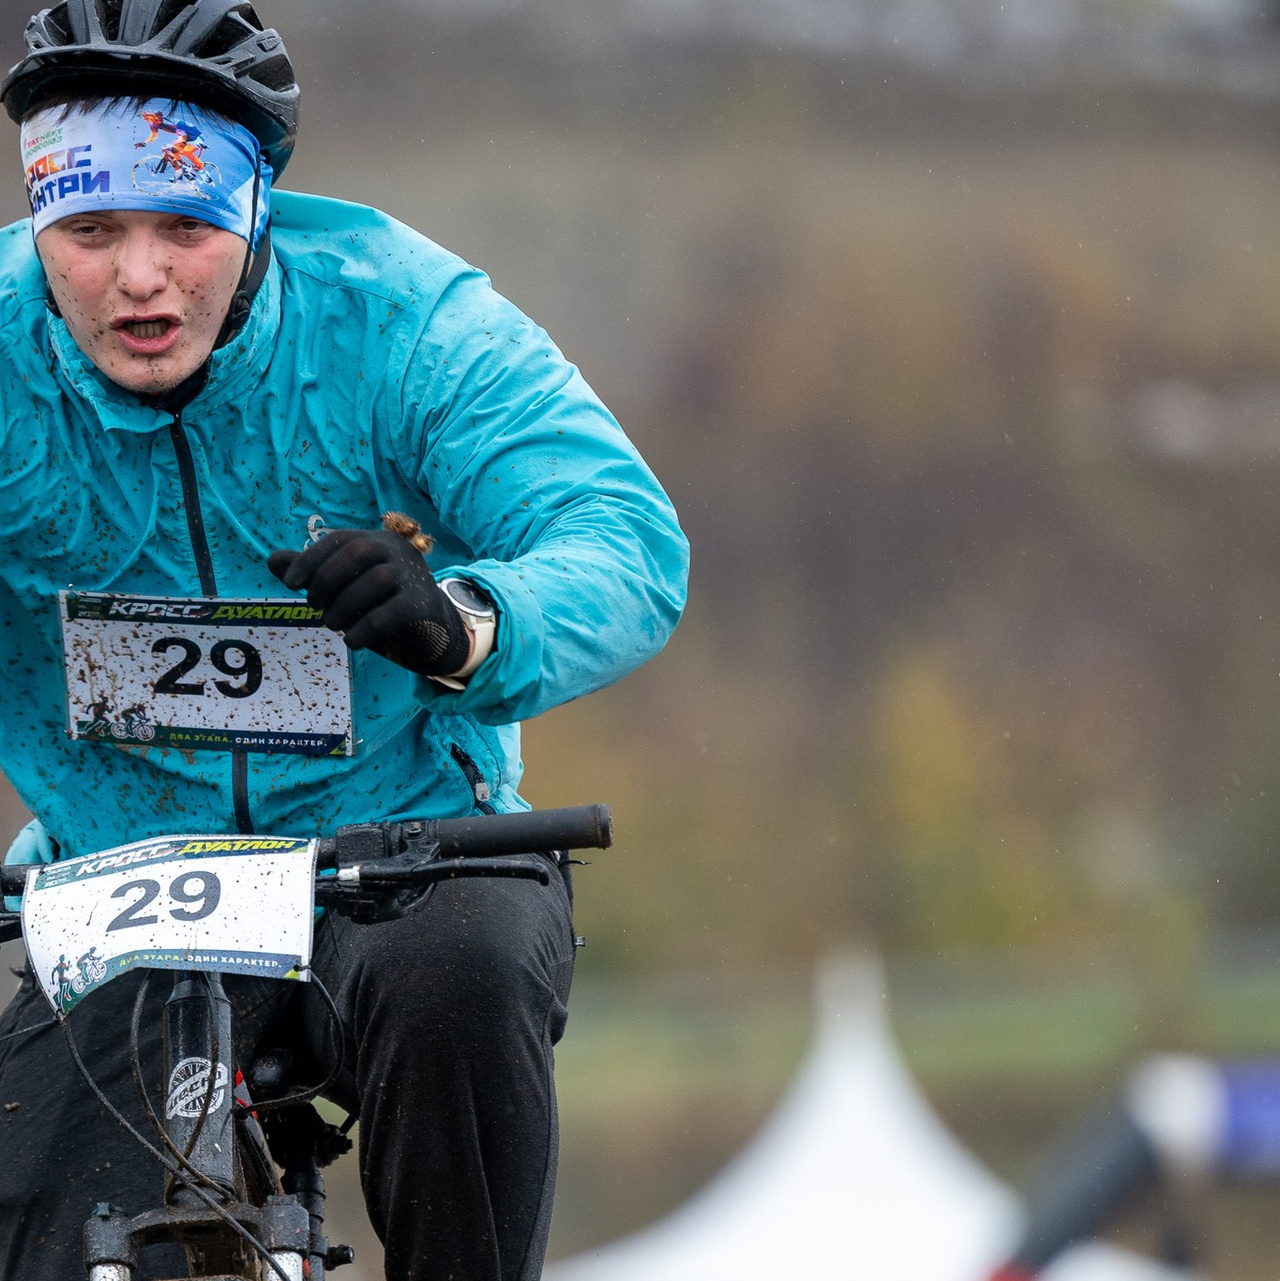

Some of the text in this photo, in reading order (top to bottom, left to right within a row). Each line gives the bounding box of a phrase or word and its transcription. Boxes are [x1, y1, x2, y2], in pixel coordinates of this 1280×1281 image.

[26, 145, 92, 190] РОСС
[109, 601, 204, 618] КРОСС
[211, 605, 323, 620] ДУАТЛОН
[151, 636, 263, 699] 29
[76, 840, 296, 877] КРОСС ДУАТЛОН
[106, 870, 221, 933] 29
[221, 956, 282, 968] ХАРАКТЕР.
